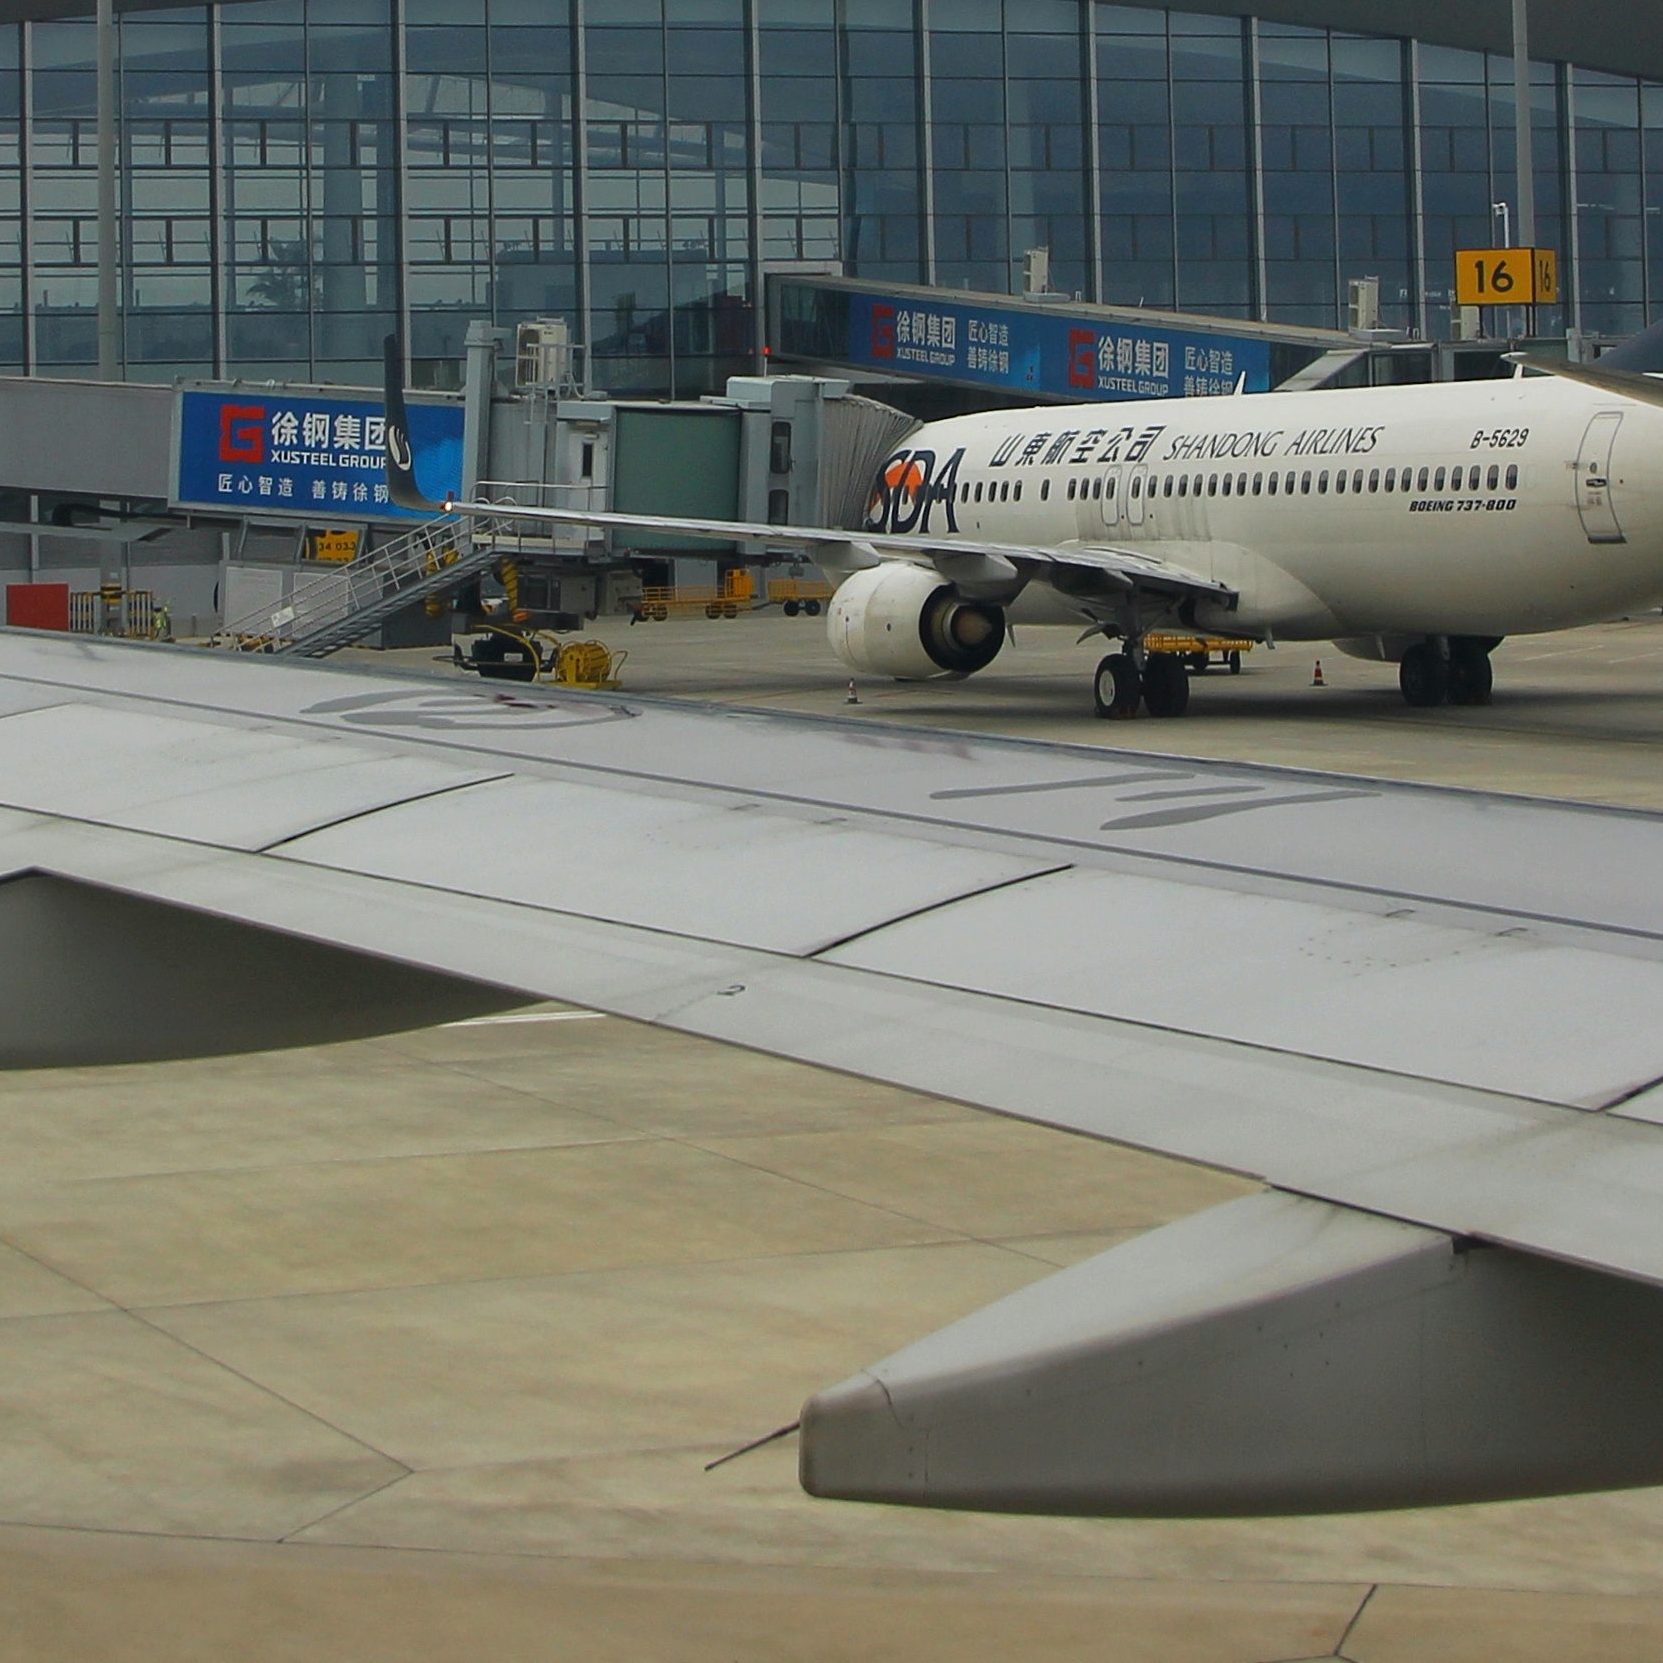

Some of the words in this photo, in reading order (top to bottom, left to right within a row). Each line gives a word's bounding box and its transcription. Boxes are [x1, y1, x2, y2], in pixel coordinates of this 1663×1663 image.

[1475, 259, 1514, 293] 16
[1539, 260, 1552, 292] 16
[896, 310, 956, 350] 徐钢集团
[968, 320, 1009, 347] 匠心智造
[896, 347, 929, 364] XUSTEEL
[930, 351, 955, 367] GROUP
[1098, 336, 1169, 379] 徐钢集团
[1184, 346, 1233, 376] 匠心智造
[1098, 375, 1137, 393] XUSTEEL
[1138, 380, 1169, 397] GROUP
[271, 411, 386, 450] 徐钢集团
[1163, 430, 1285, 460] SHANDONG
[1283, 426, 1385, 456] AIRLINES
[1469, 428, 1529, 449] B-5629
[271, 449, 337, 468] XUSTEEL
[218, 473, 294, 497] 匠心智造
[311, 480, 389, 504] 善铸徐钢
[863, 447, 966, 534] SDA
[1409, 500, 1454, 512] BOEING
